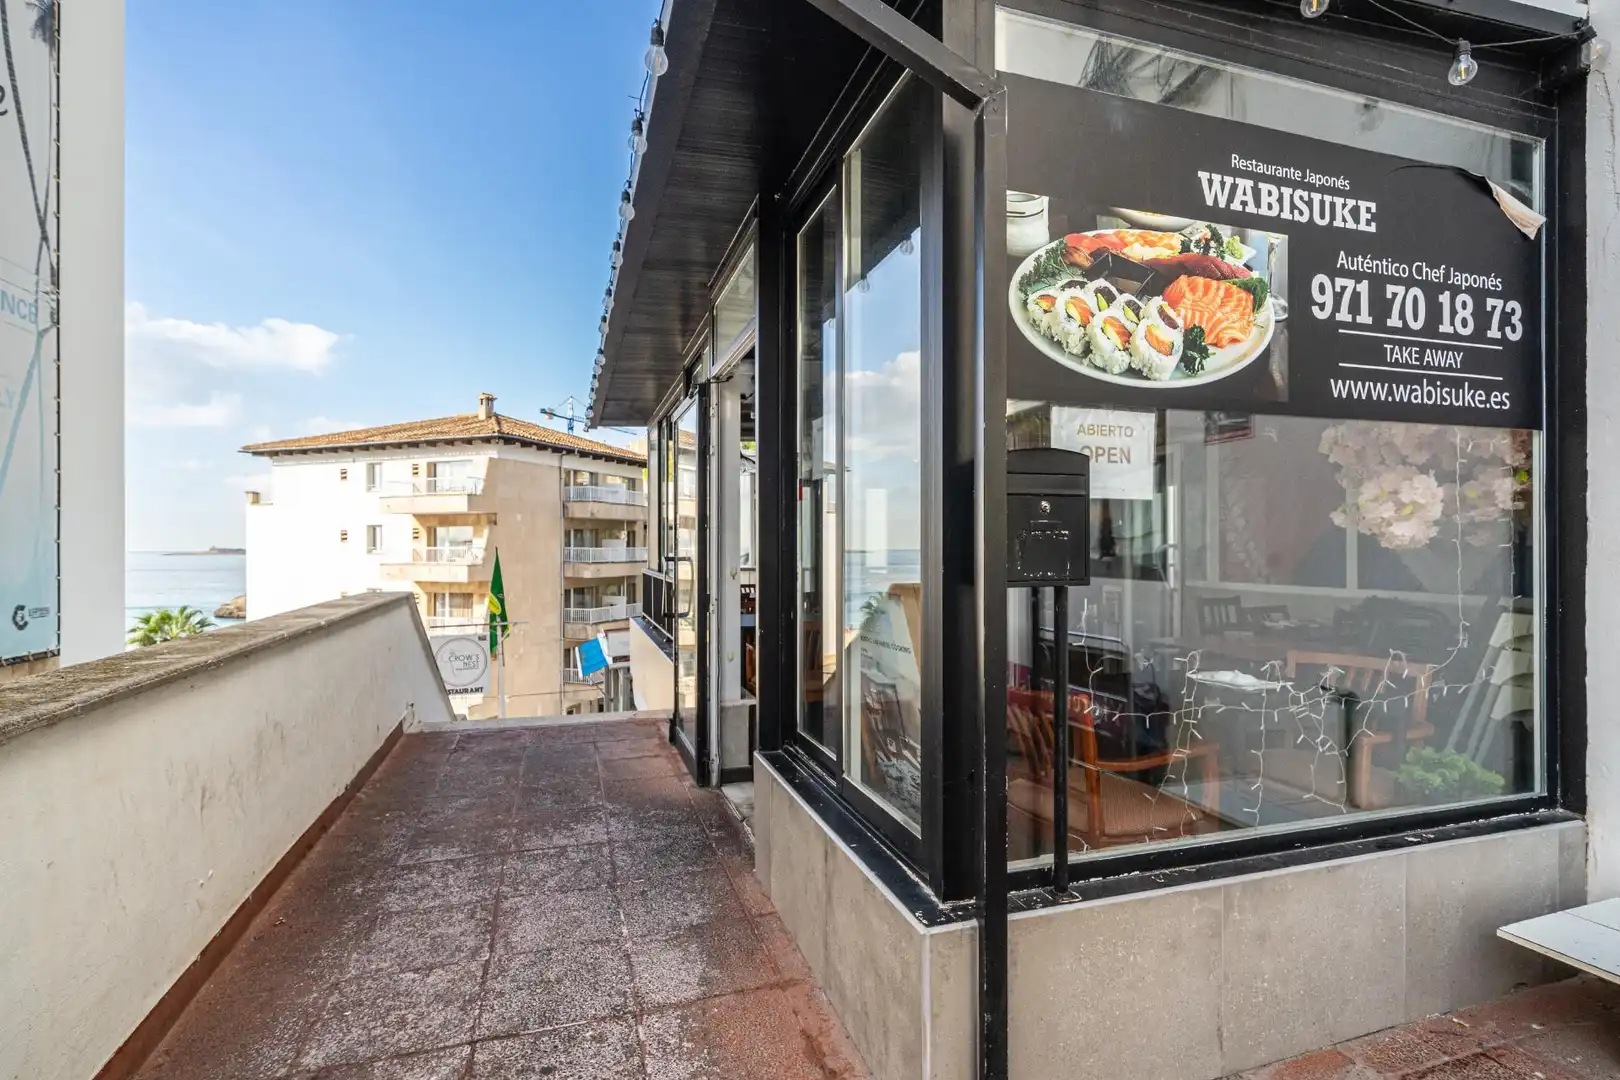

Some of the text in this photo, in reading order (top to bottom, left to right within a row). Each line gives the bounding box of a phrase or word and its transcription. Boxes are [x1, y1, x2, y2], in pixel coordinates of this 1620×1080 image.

[1231, 153, 1350, 191] Restaurante Japonés
[1197, 170, 1377, 233] WABISUKE
[1337, 250, 1503, 291] Auténtico Chef Japonés
[1311, 273, 1523, 342] 971 70 18 73
[1384, 343, 1464, 369] TAKE AWAY
[1330, 378, 1511, 410] www.wabisuke.es
[1076, 423, 1134, 438] ABIERTO
[1080, 445, 1132, 464] OPEN
